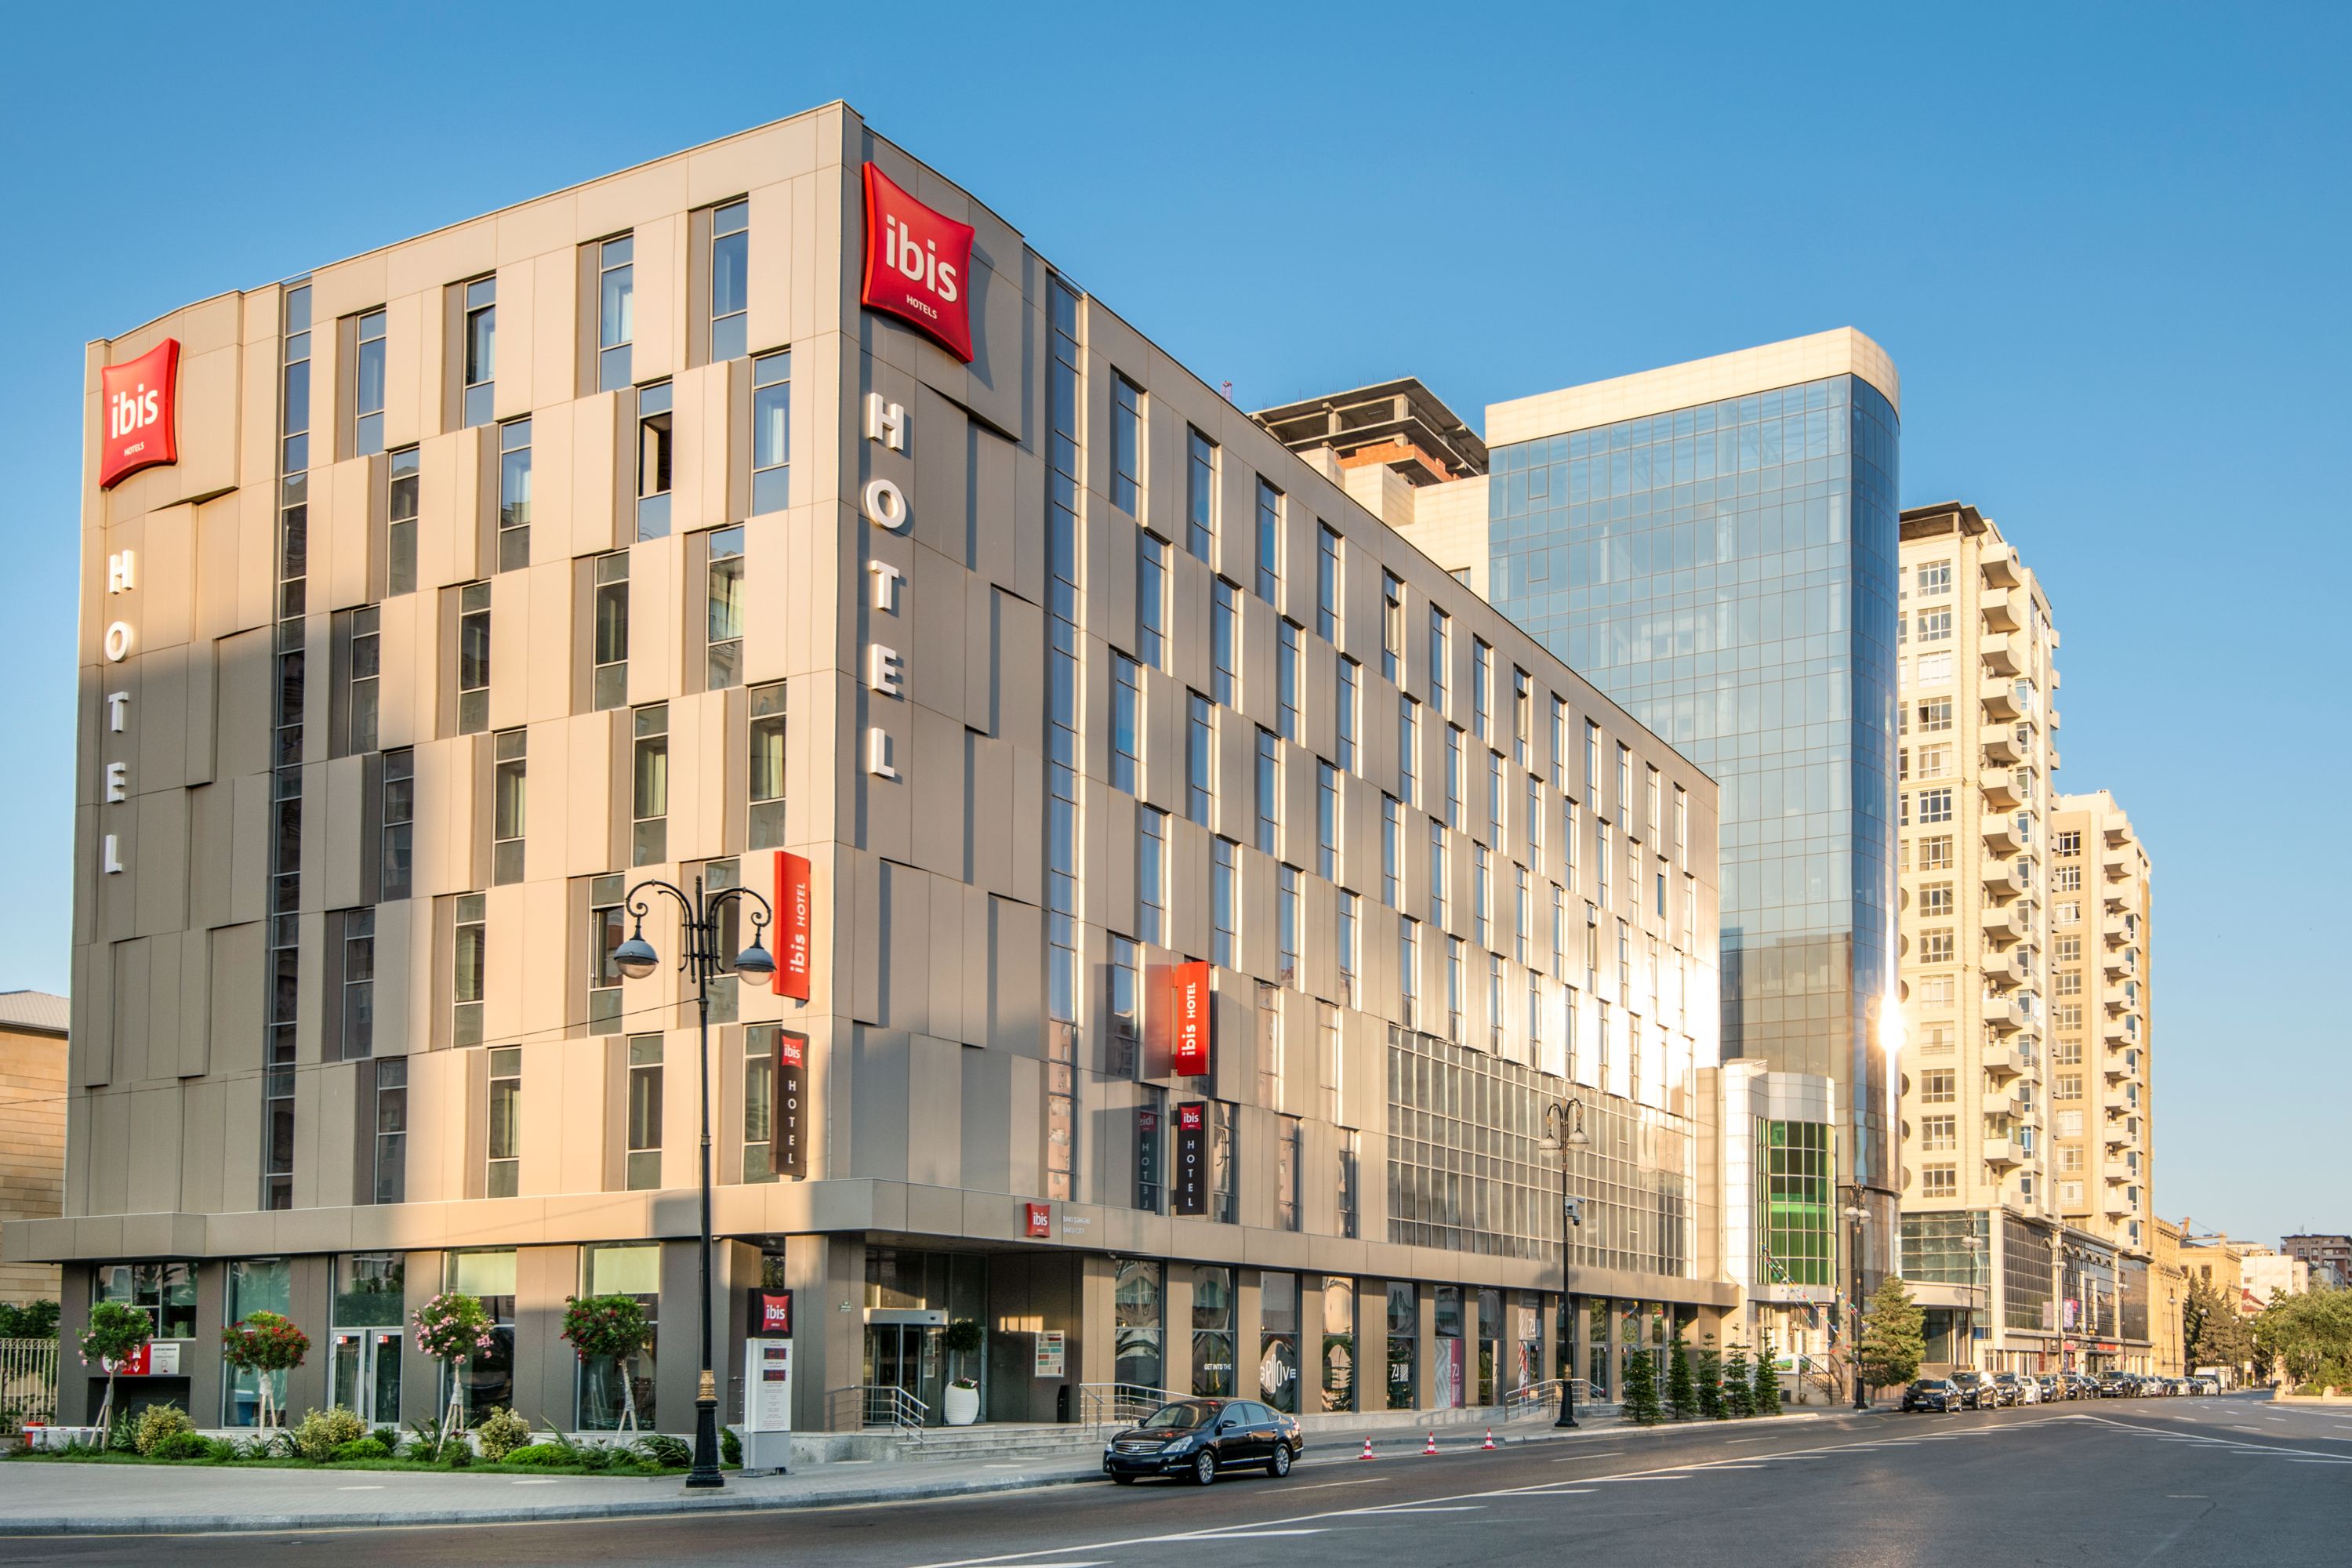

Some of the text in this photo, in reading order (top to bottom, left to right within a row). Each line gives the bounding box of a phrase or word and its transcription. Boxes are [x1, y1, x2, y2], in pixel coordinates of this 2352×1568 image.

[886, 213, 957, 303] ibis
[906, 294, 938, 319] HOTELS
[111, 383, 158, 439] ibis
[124, 441, 144, 457] HOTELS
[866, 392, 906, 779] HOTEL
[104, 549, 136, 874] HOTEL
[790, 882, 806, 974] ibis HOTEL
[1181, 982, 1196, 1055] ibis HOTEL
[784, 1044, 800, 1058] ibis
[788, 1080, 797, 1164] HOTEL
[1183, 1112, 1200, 1123] ibis
[1186, 1140, 1195, 1207] HOTEL
[1033, 1212, 1047, 1225] ibis
[766, 1304, 786, 1319] ibis
